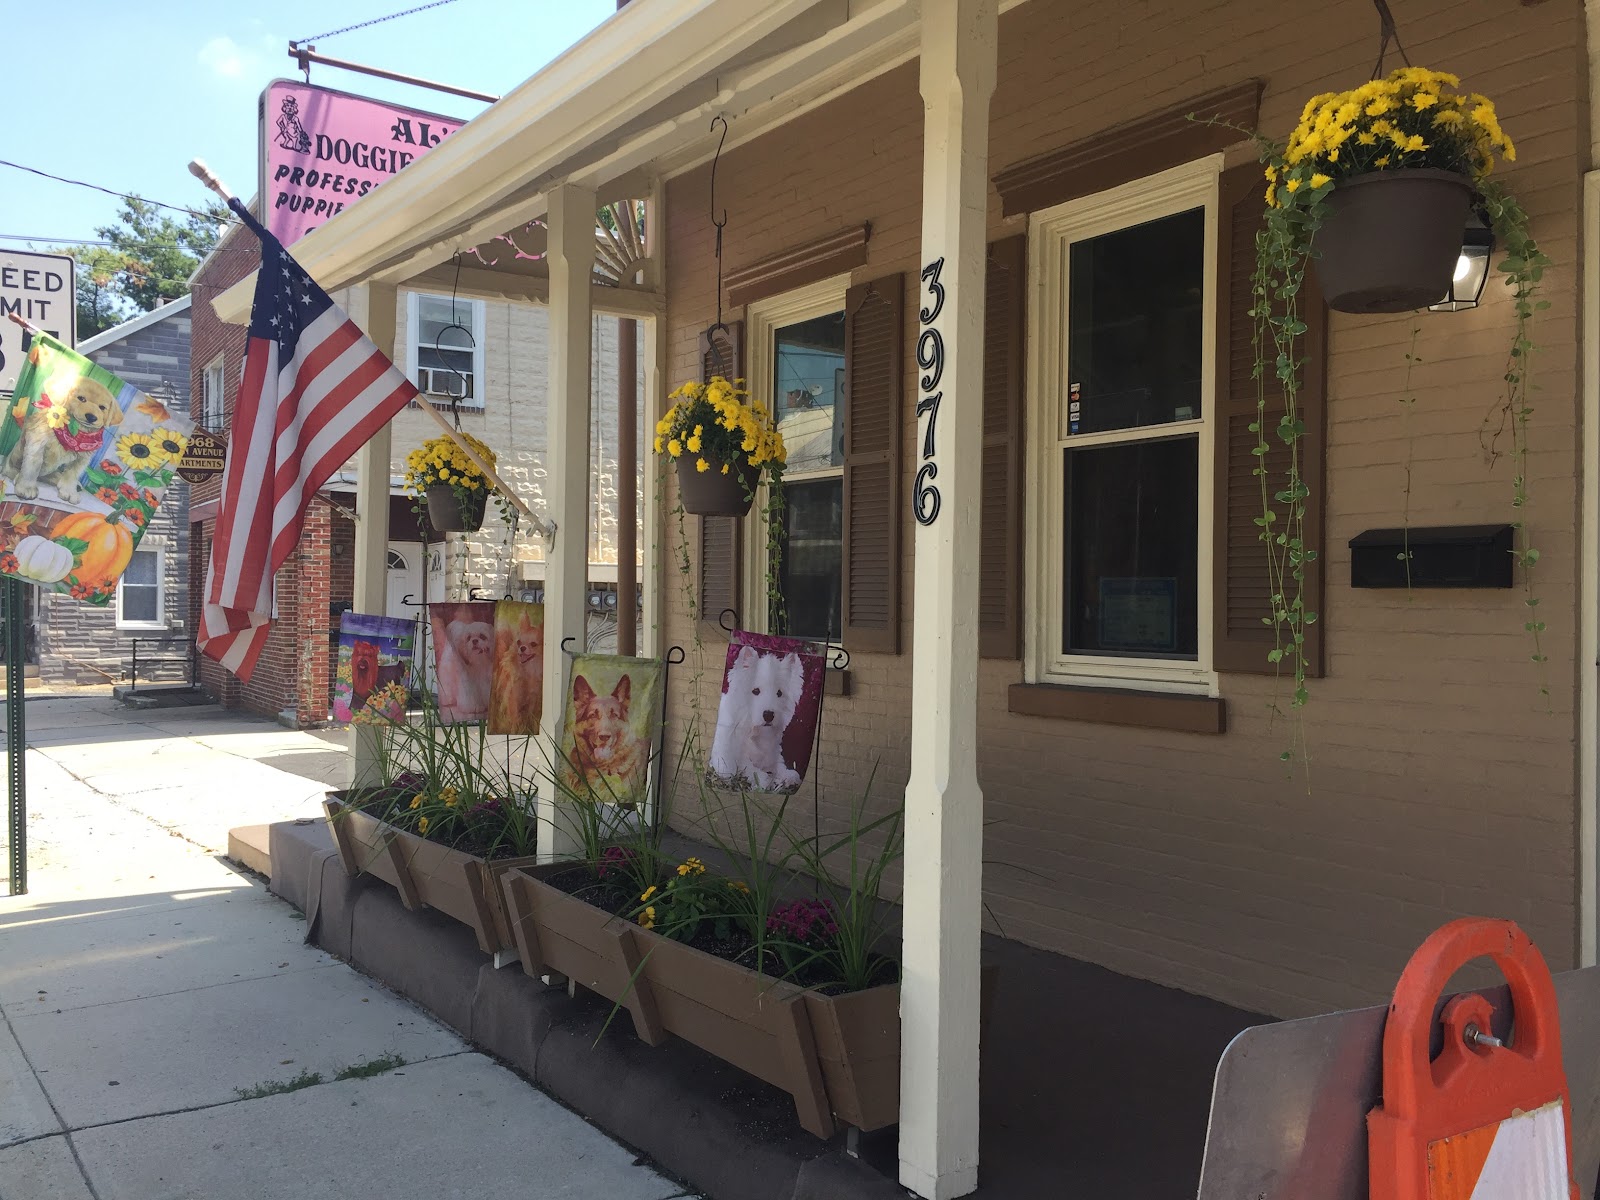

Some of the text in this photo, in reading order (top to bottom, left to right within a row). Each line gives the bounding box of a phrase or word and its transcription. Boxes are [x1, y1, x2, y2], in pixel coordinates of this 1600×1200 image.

[391, 117, 457, 149] AL'
[274, 164, 379, 197] PROFESS
[2, 267, 63, 292] EED
[0, 296, 51, 320] MIT
[912, 256, 945, 526] 3976
[188, 438, 214, 447] 968
[193, 448, 223, 456] AVENUE
[181, 460, 221, 468] ARTMENTS
